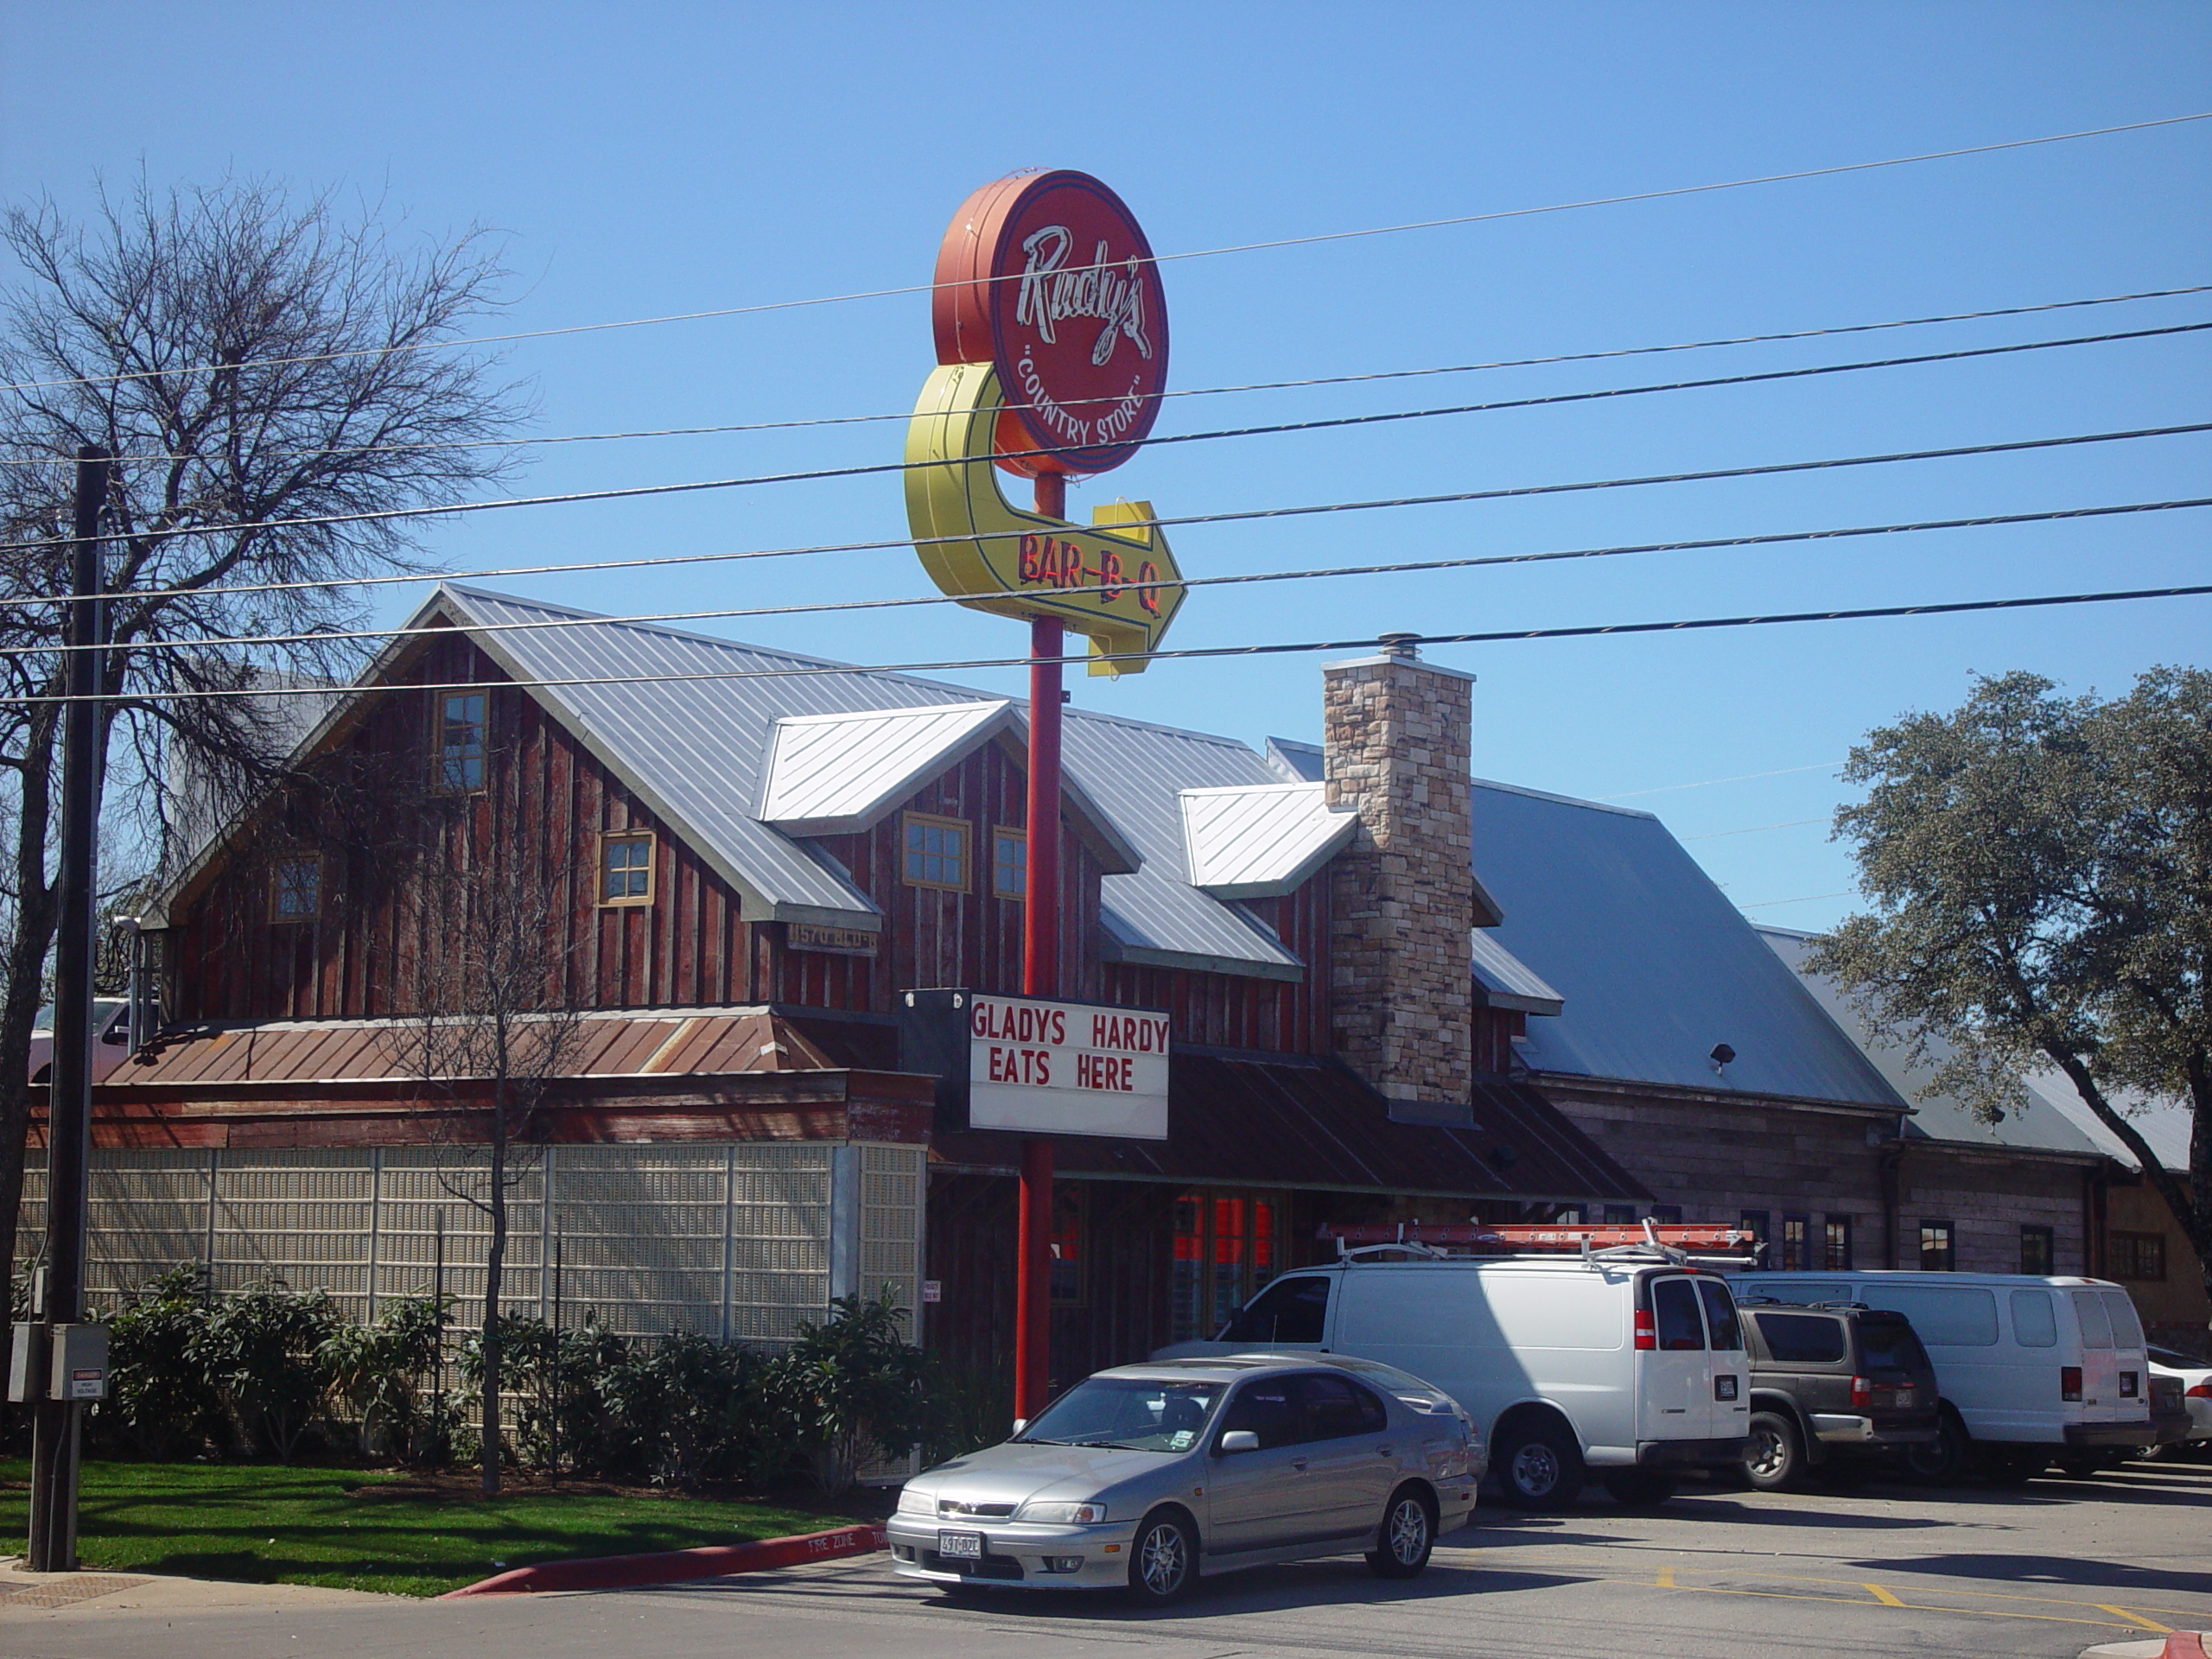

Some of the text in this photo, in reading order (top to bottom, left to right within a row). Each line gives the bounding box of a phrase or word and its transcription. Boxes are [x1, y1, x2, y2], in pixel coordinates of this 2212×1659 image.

[1016, 225, 1152, 366] Rudy's
[1019, 535, 1161, 619] BAR-B-Q
[971, 1002, 1169, 1053] GLADYS HARDY
[989, 1047, 1133, 1091] EATS HERE
[808, 1537, 829, 1553] FIRE
[831, 1533, 855, 1548] ZONE
